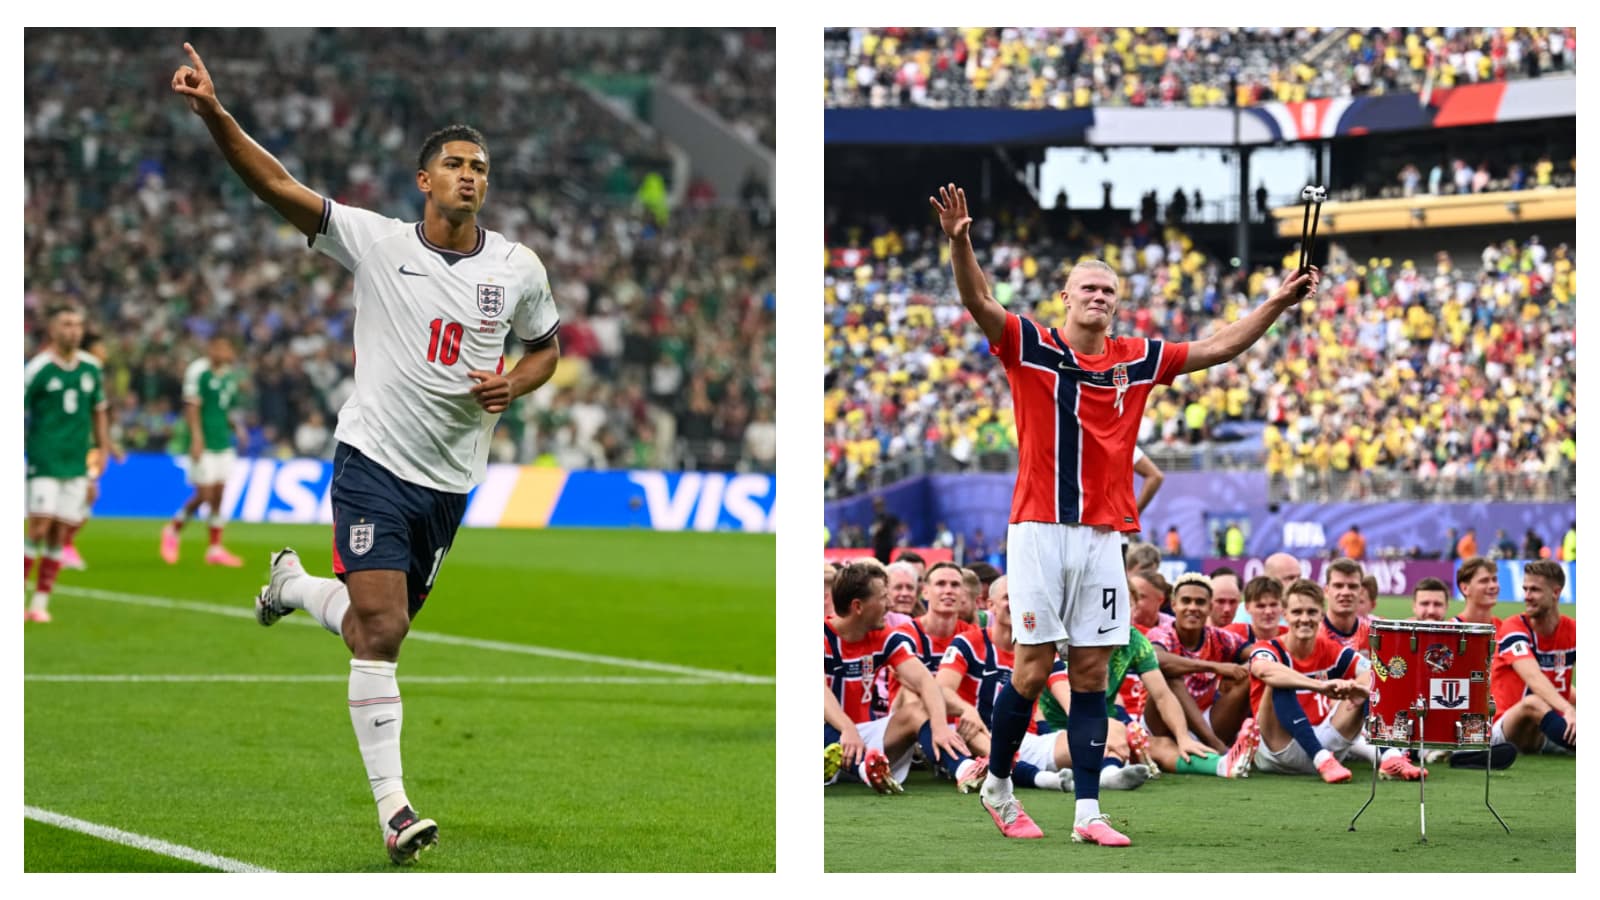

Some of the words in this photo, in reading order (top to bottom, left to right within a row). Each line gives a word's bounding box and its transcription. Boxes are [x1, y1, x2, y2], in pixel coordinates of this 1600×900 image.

[427, 318, 464, 366] 10
[627, 471, 777, 533] VIS
[1102, 588, 1116, 620] 9
